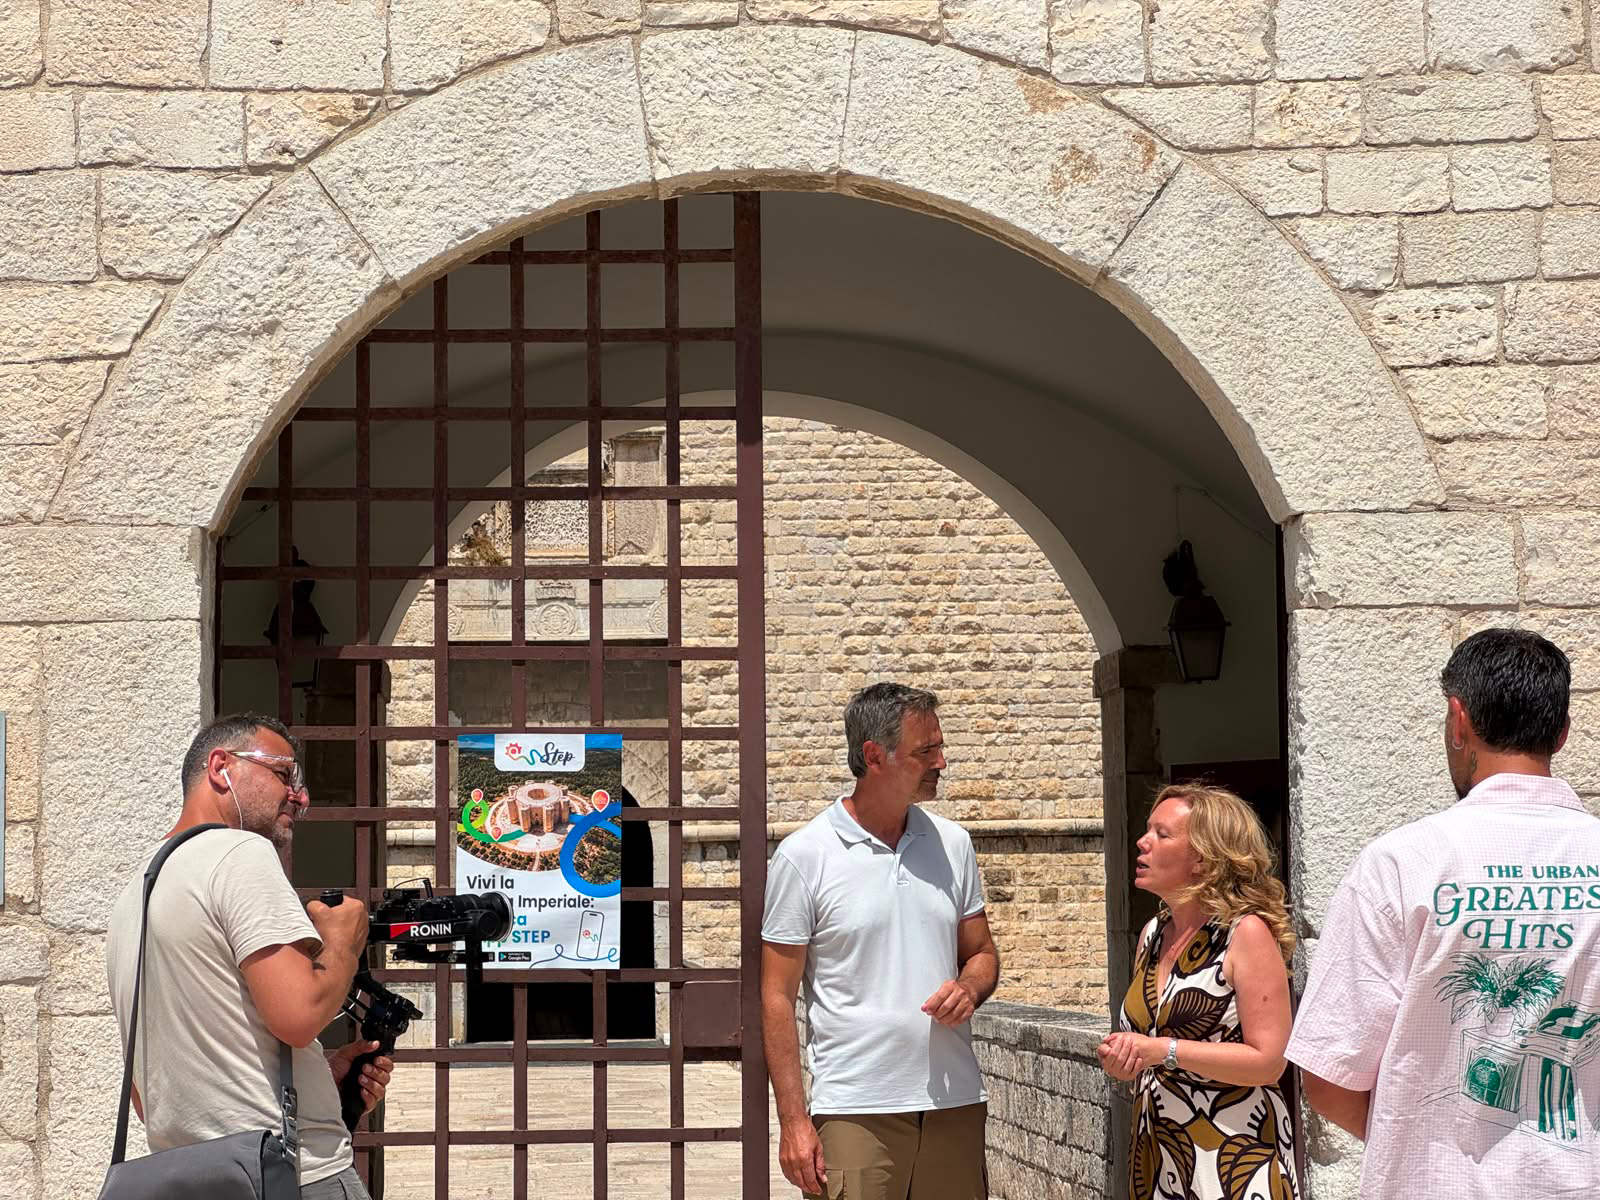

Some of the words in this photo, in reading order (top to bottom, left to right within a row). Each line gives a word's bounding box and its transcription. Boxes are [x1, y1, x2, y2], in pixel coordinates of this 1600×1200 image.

[540, 742, 575, 766] Step
[1483, 865, 1523, 878] THE
[1532, 865, 1600, 878] URBAN
[466, 874, 496, 889] Vivi
[500, 874, 514, 889] la
[518, 894, 595, 912] Imperiale:
[410, 923, 452, 937] RONIN
[512, 930, 551, 943] STEP
[1462, 918, 1575, 949] HITS
